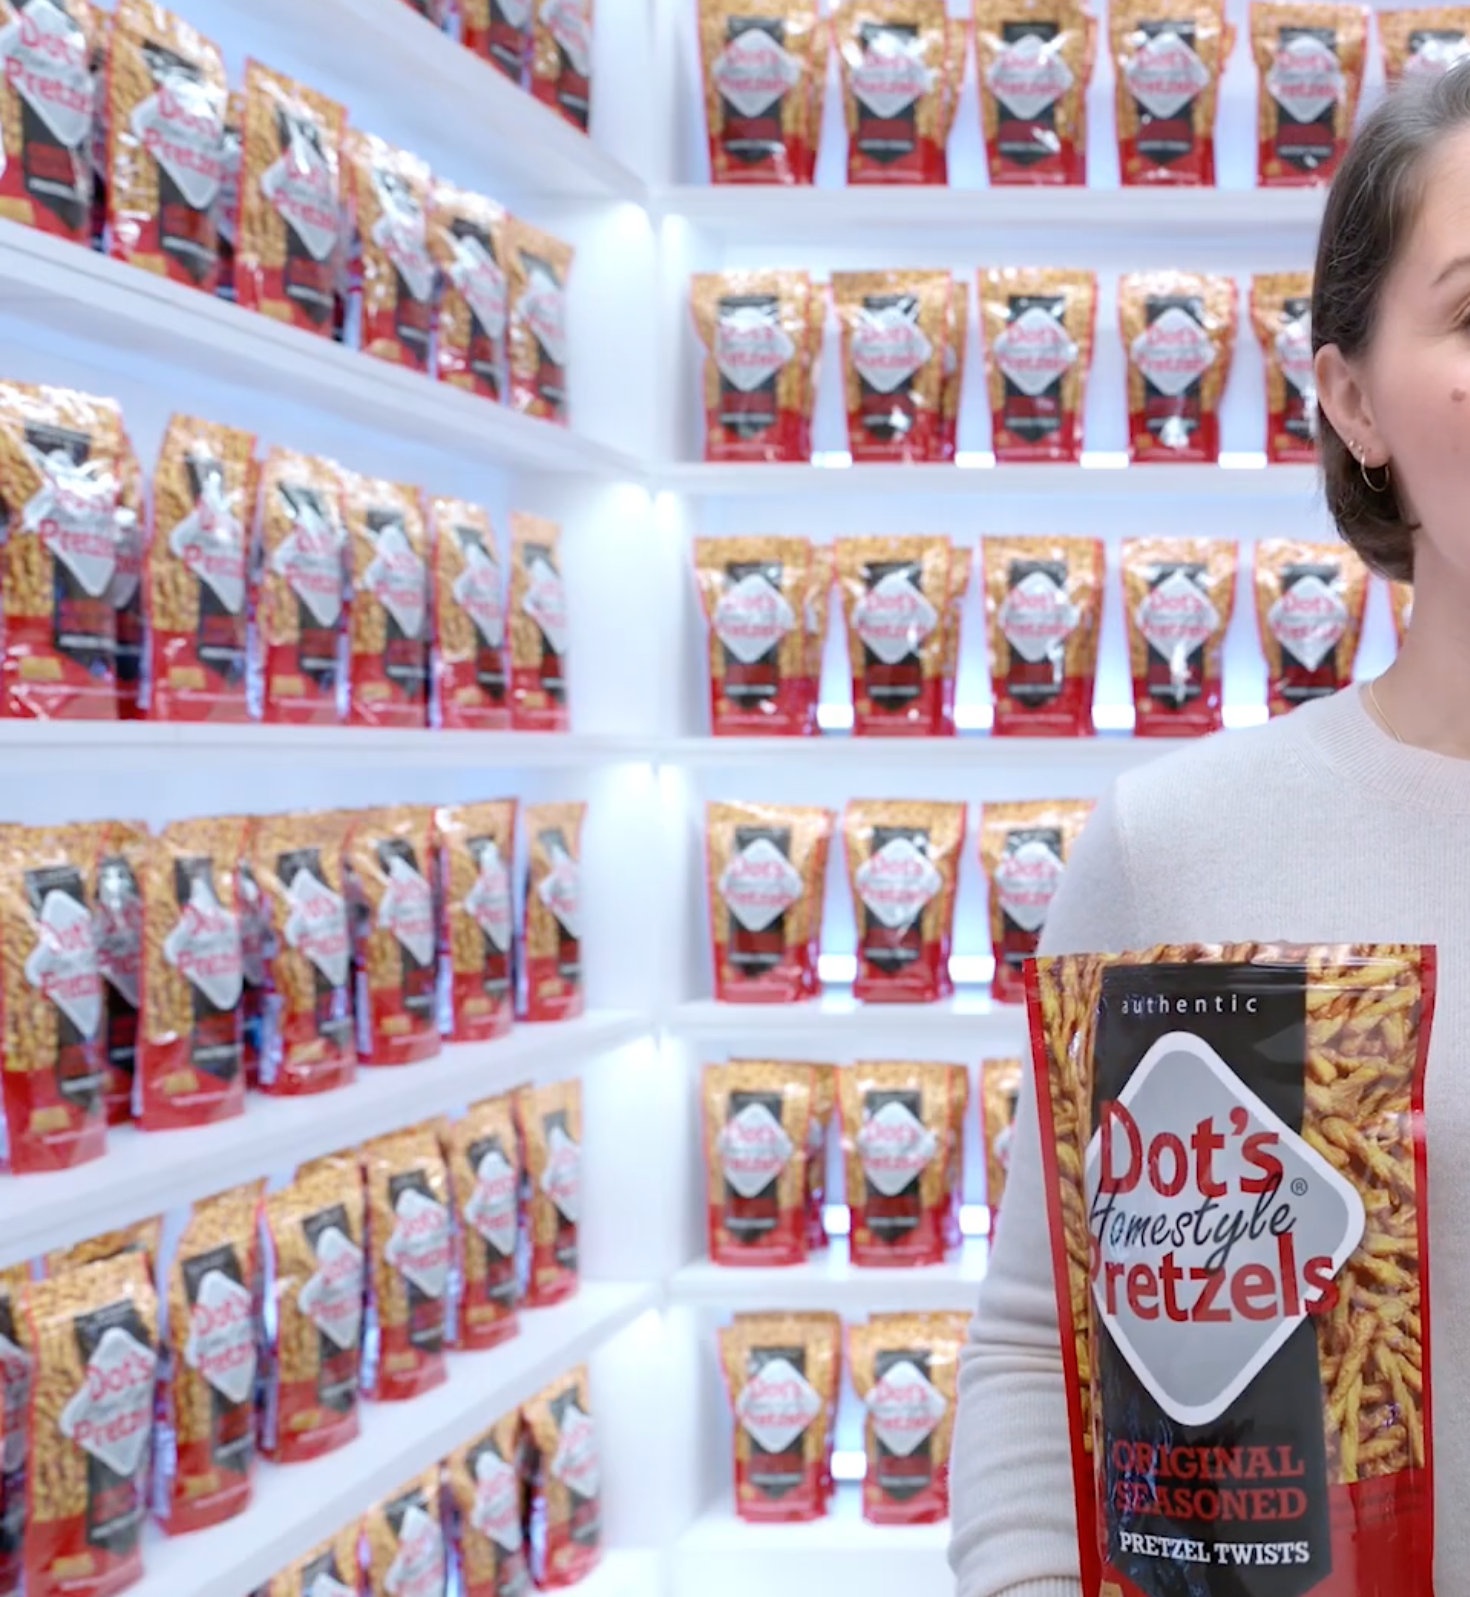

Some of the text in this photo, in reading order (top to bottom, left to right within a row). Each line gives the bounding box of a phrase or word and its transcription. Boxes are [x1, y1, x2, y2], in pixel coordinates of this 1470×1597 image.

[1121, 994, 1257, 1015] authentic
[1101, 1100, 1284, 1198] Dot's
[1089, 1172, 1297, 1276] Homestyle
[1113, 1439, 1304, 1480] ORIGINAL
[1115, 1480, 1308, 1522] SEASONED
[1119, 1531, 1310, 1566] PRETZEL TWISTS
